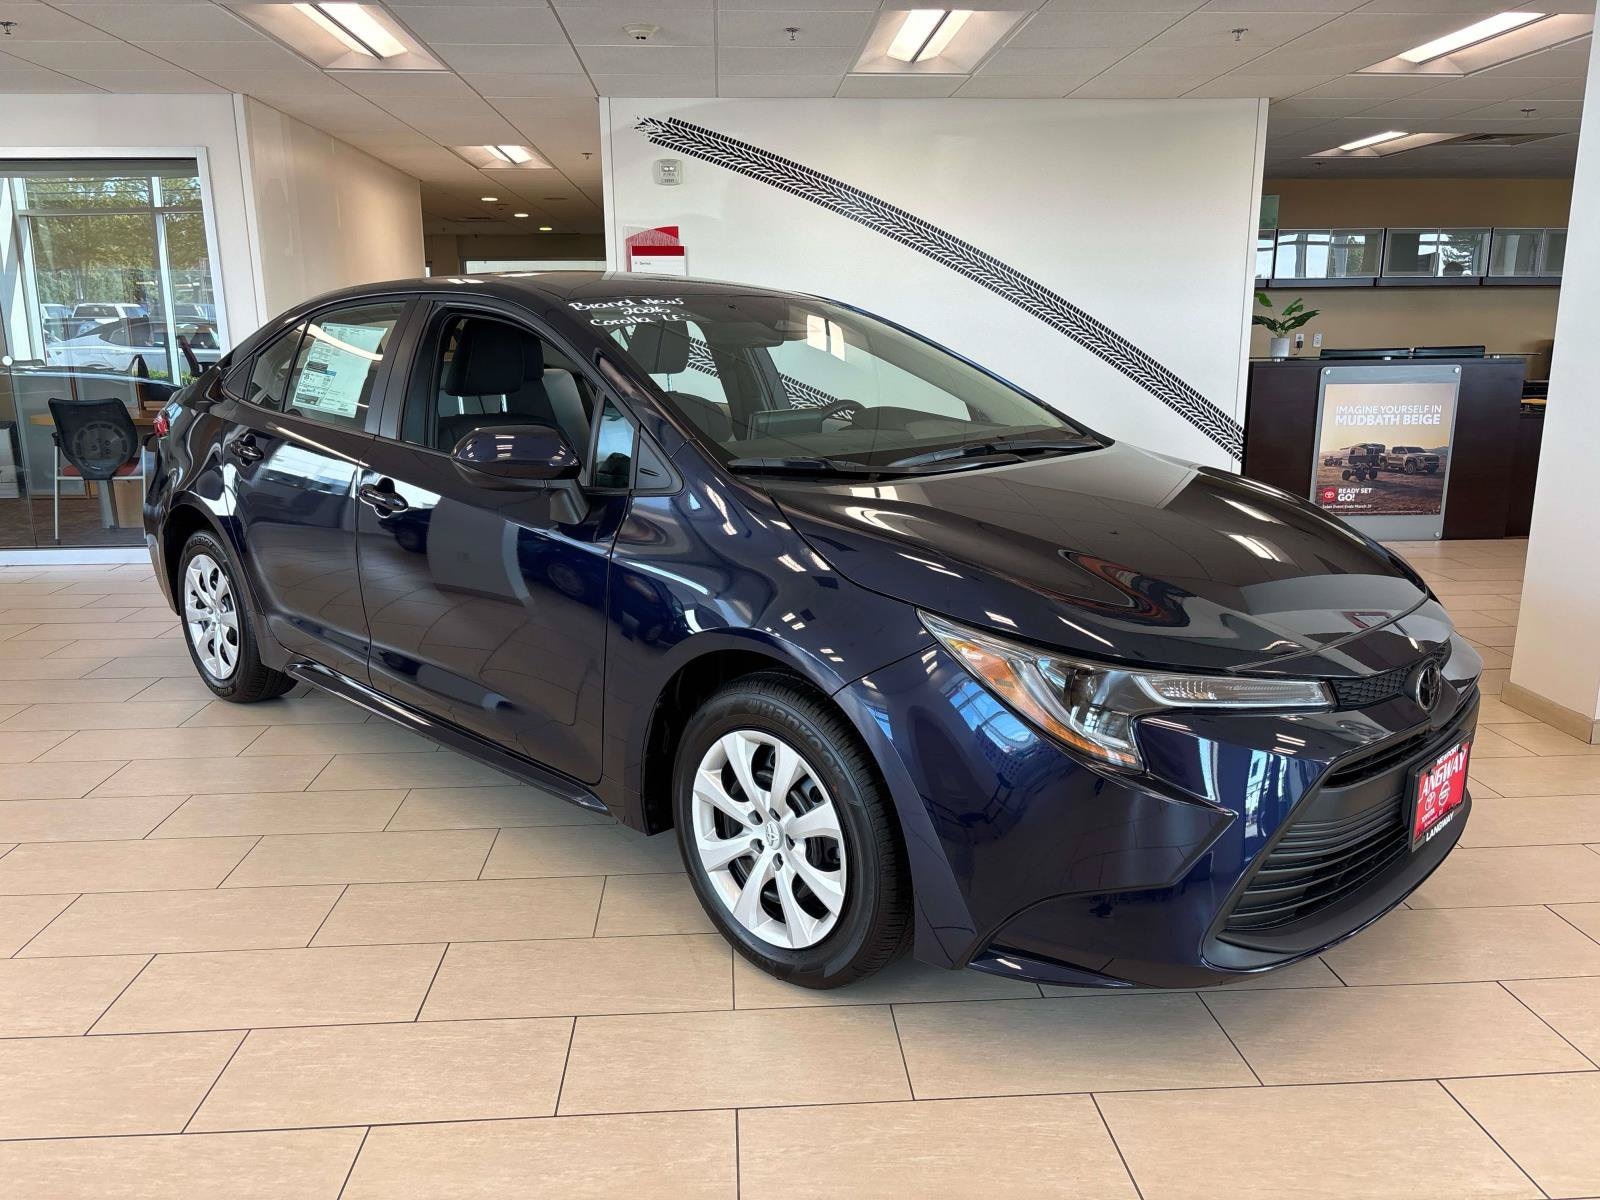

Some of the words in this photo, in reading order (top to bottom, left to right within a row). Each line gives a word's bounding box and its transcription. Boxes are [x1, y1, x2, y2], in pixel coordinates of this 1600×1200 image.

[568, 299, 637, 311] Brand
[641, 297, 684, 305] New
[620, 306, 671, 315] 2026
[590, 316, 655, 326] Corolla
[1335, 405, 1379, 415] IMAGINE
[1380, 404, 1430, 414] YOURSELF
[1431, 404, 1442, 413] IN
[1335, 414, 1400, 426] MUDBATH
[1402, 414, 1441, 425] BEIGE
[1337, 493, 1355, 502] GO!
[1425, 811, 1455, 842] LANGWAY
